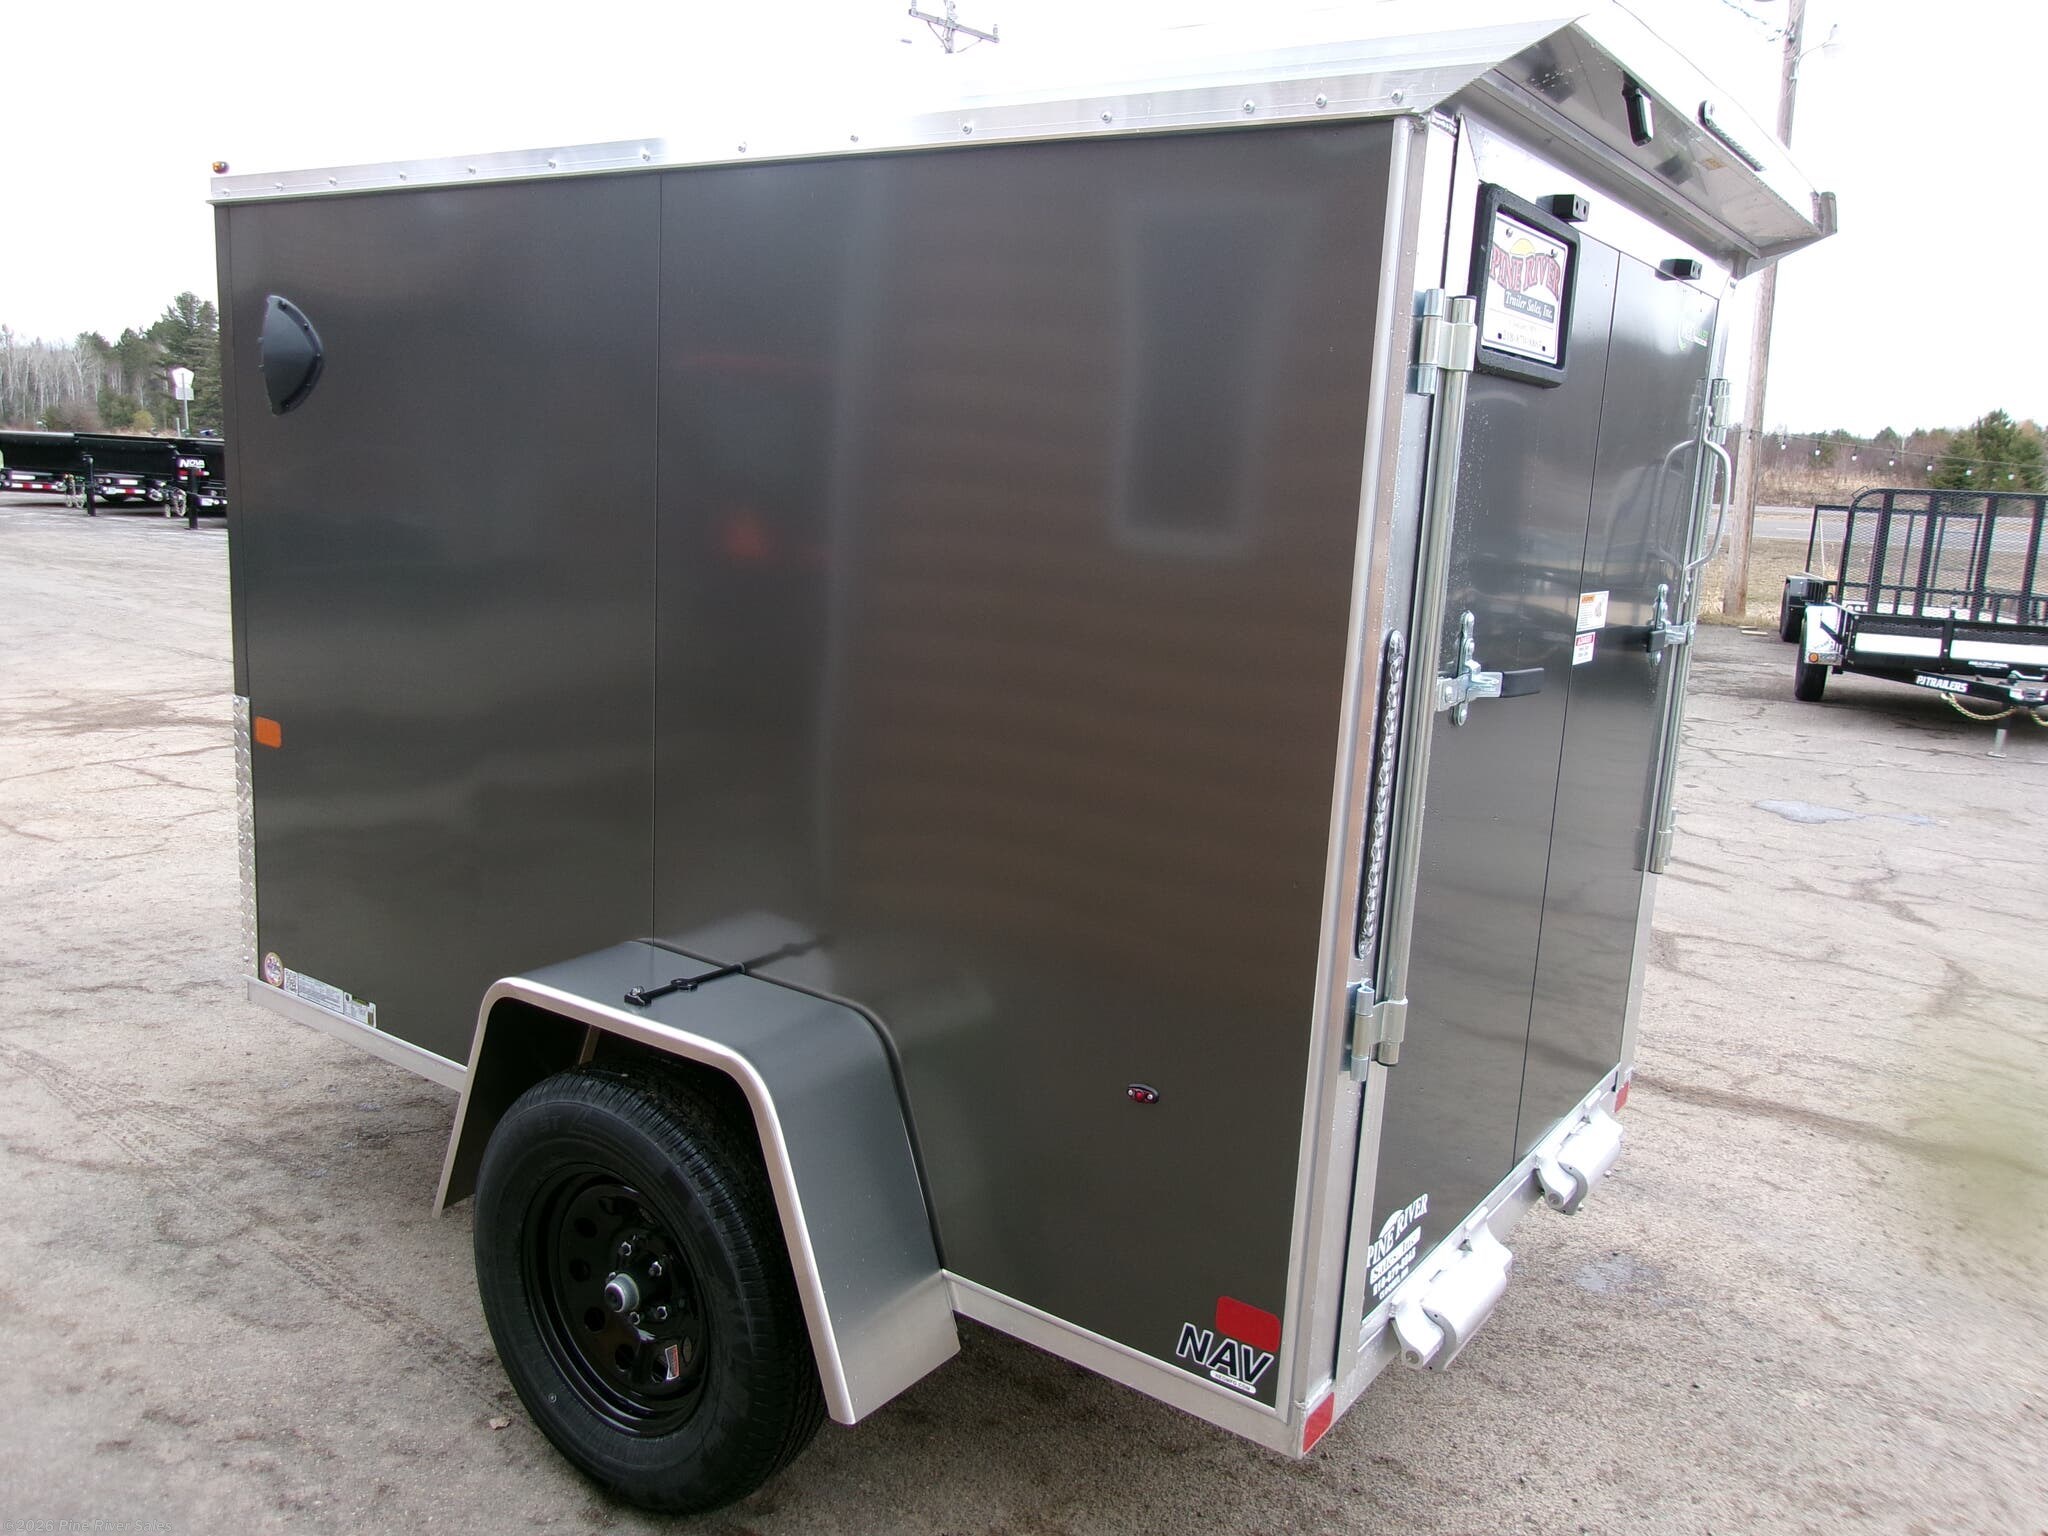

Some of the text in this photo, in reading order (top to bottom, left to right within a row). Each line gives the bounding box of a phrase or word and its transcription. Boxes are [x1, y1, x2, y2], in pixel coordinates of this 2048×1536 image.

[1489, 243, 1561, 301] PINE RIVER
[1505, 291, 1527, 309] Trailer
[179, 459, 206, 469] NOVA
[1366, 1193, 1429, 1268] PINE RIVER
[1176, 1322, 1275, 1385] NAV
